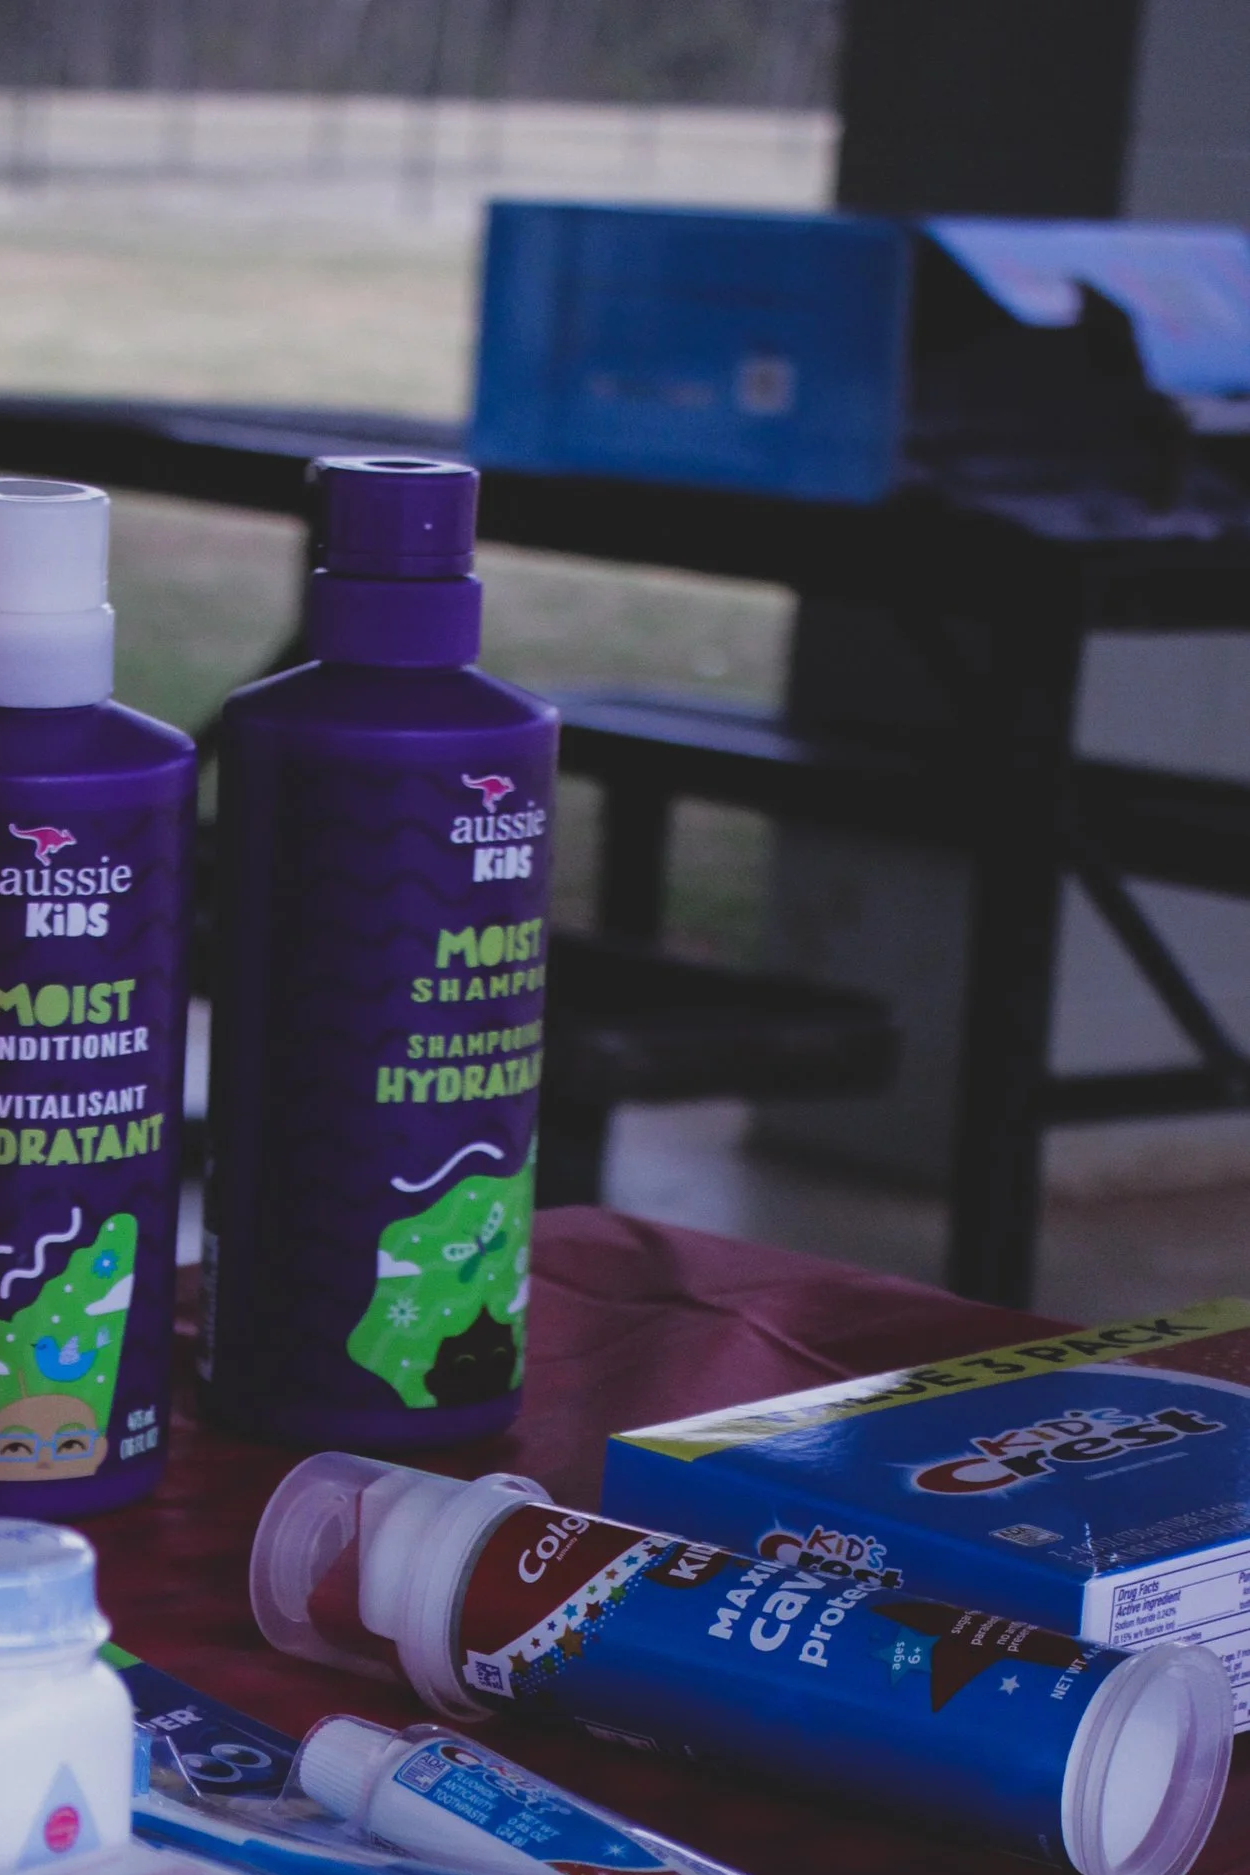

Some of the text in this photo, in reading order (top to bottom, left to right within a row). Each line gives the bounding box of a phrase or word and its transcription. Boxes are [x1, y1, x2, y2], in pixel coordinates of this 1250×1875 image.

[450, 801, 545, 843] aussie
[435, 917, 543, 969] MOIST
[962, 1350, 1027, 1375] 3
[1026, 1318, 1209, 1364] PACK
[916, 1407, 1226, 1493] Crest
[1116, 1590, 1181, 1618] Active ingredient
[1118, 1580, 1159, 1602] Drug Facts
[892, 1641, 905, 1671] ages
[907, 1646, 922, 1664] 6+
[1050, 1674, 1074, 1700] NET
[433, 1788, 490, 1824] TOOTHPASTE
[442, 1779, 498, 1811] ANTICAVITY
